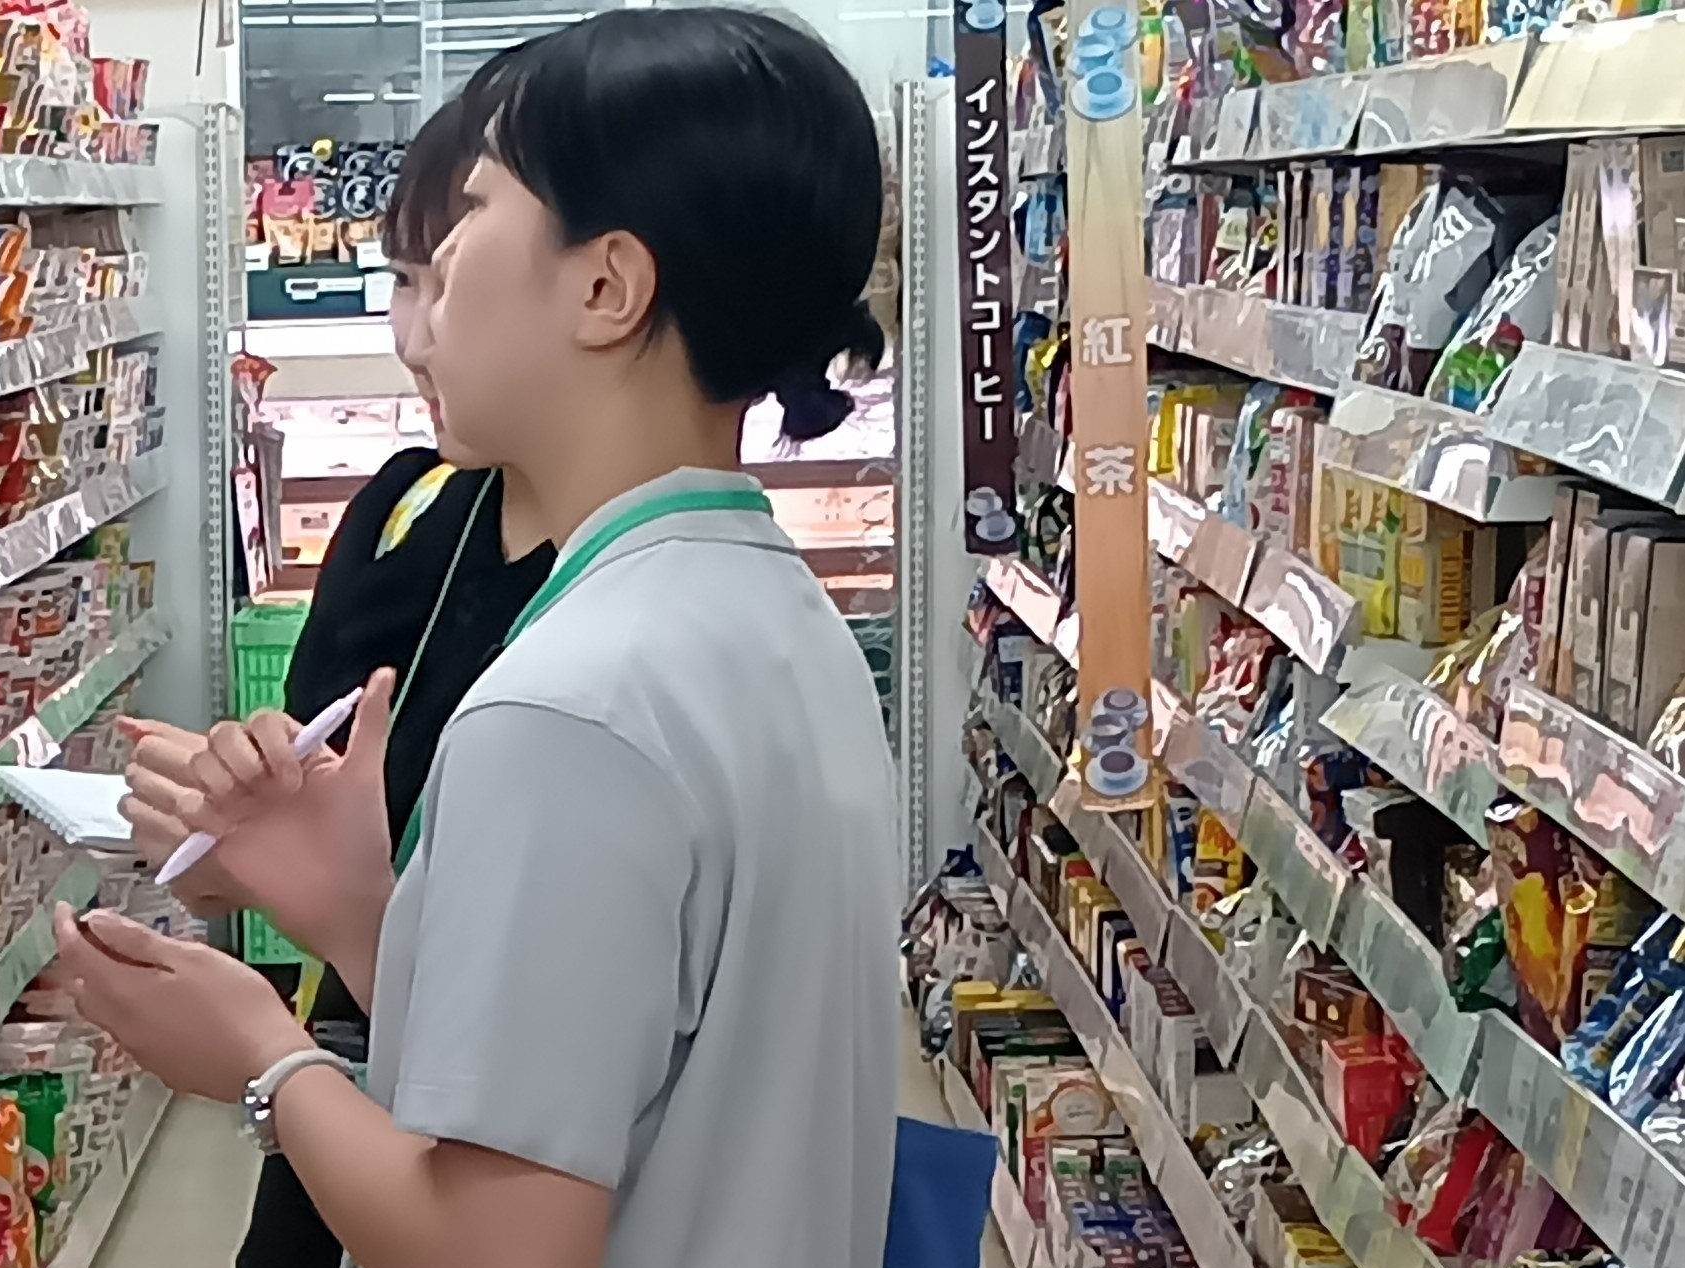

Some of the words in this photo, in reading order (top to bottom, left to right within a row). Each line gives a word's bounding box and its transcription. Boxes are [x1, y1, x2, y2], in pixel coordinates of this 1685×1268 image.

[964, 79, 1004, 441] インスタントコーヒー
[1080, 317, 1137, 498] 紅茶
